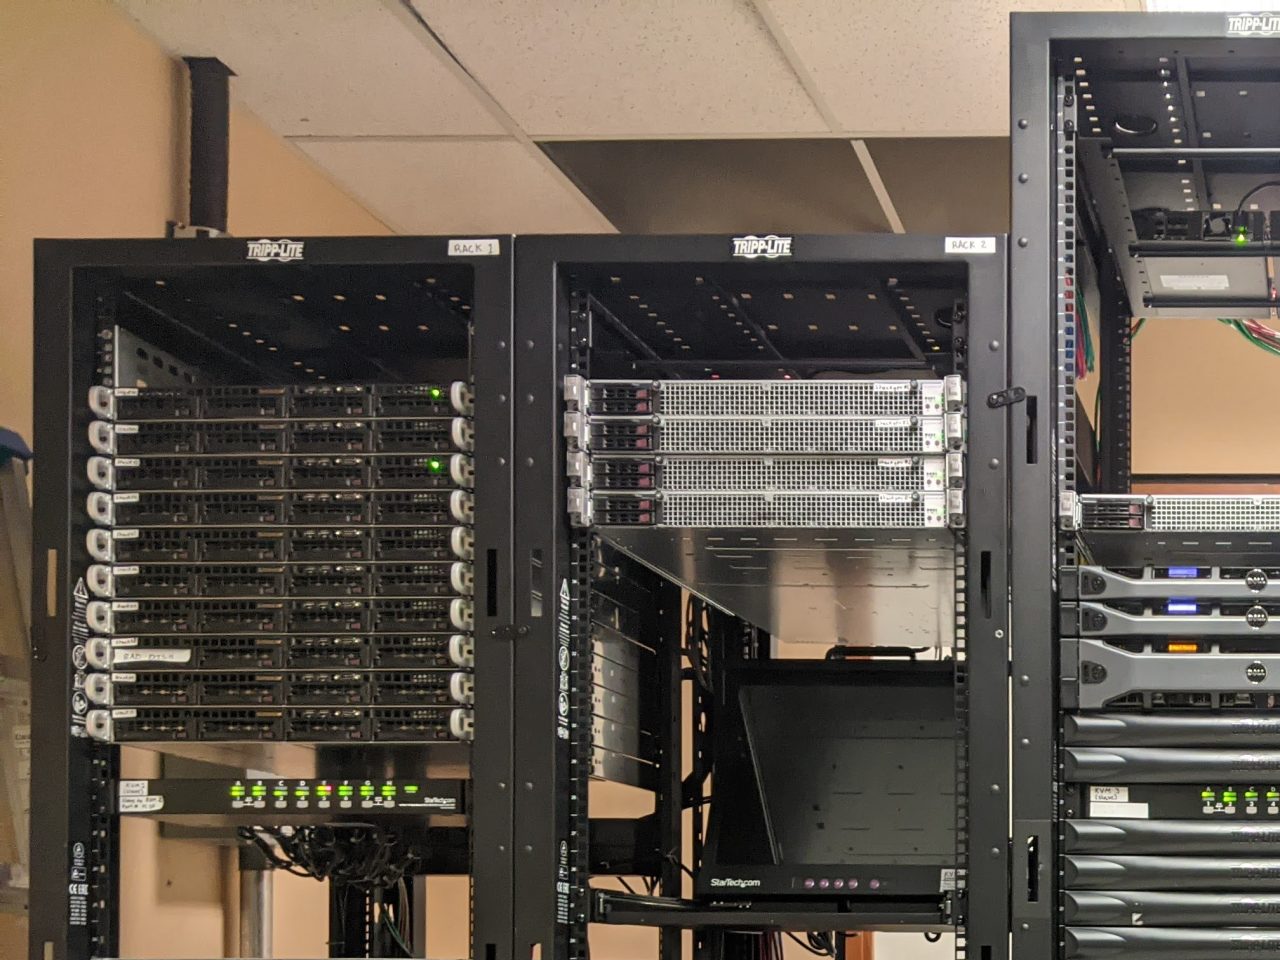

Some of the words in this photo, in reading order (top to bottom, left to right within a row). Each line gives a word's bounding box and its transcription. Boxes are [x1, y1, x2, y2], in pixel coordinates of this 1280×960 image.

[453, 244, 483, 254] RACK
[952, 240, 976, 250] RACK
[981, 240, 988, 249] 2
[710, 878, 761, 888] StarTech.com
